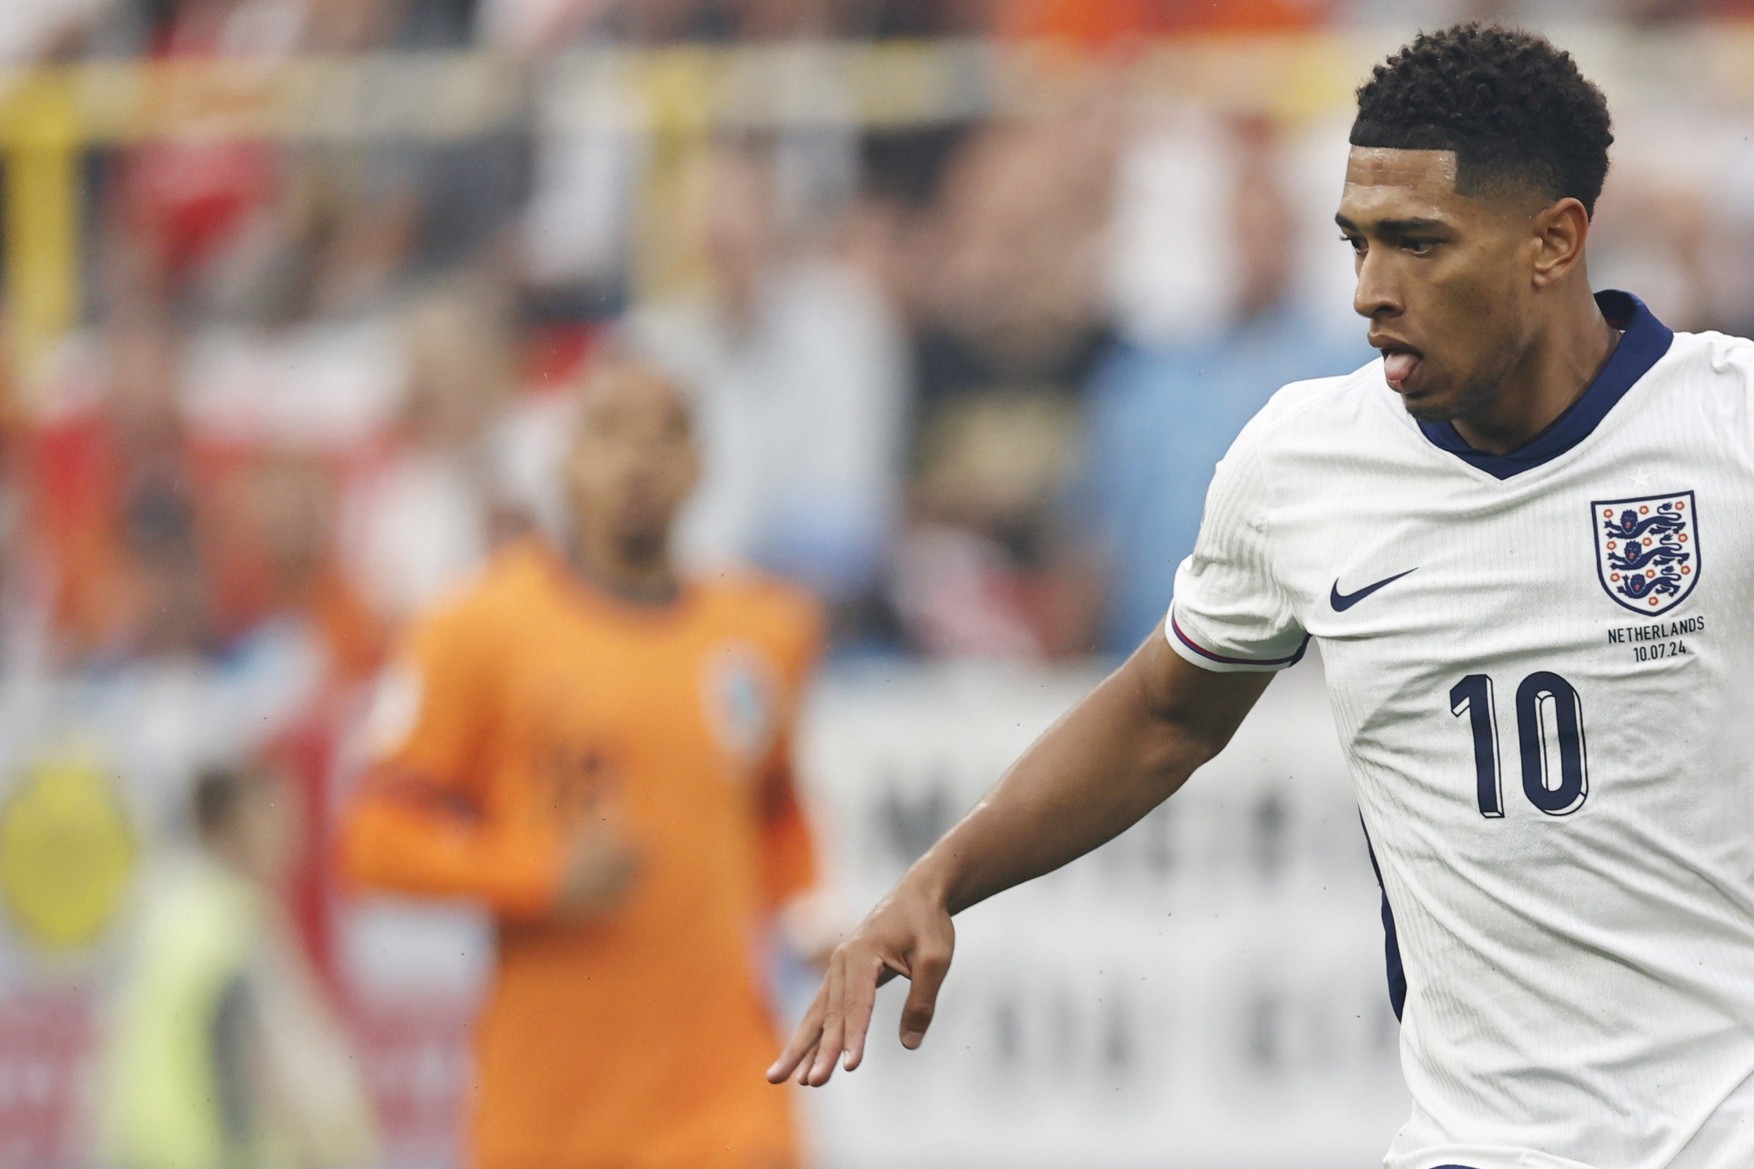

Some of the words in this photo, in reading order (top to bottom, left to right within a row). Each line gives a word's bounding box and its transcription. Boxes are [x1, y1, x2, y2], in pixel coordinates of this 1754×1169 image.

[1607, 615, 1705, 644] NETHERLANDS
[1633, 640, 1687, 662] 10.07.24
[1449, 670, 1589, 818] 10
